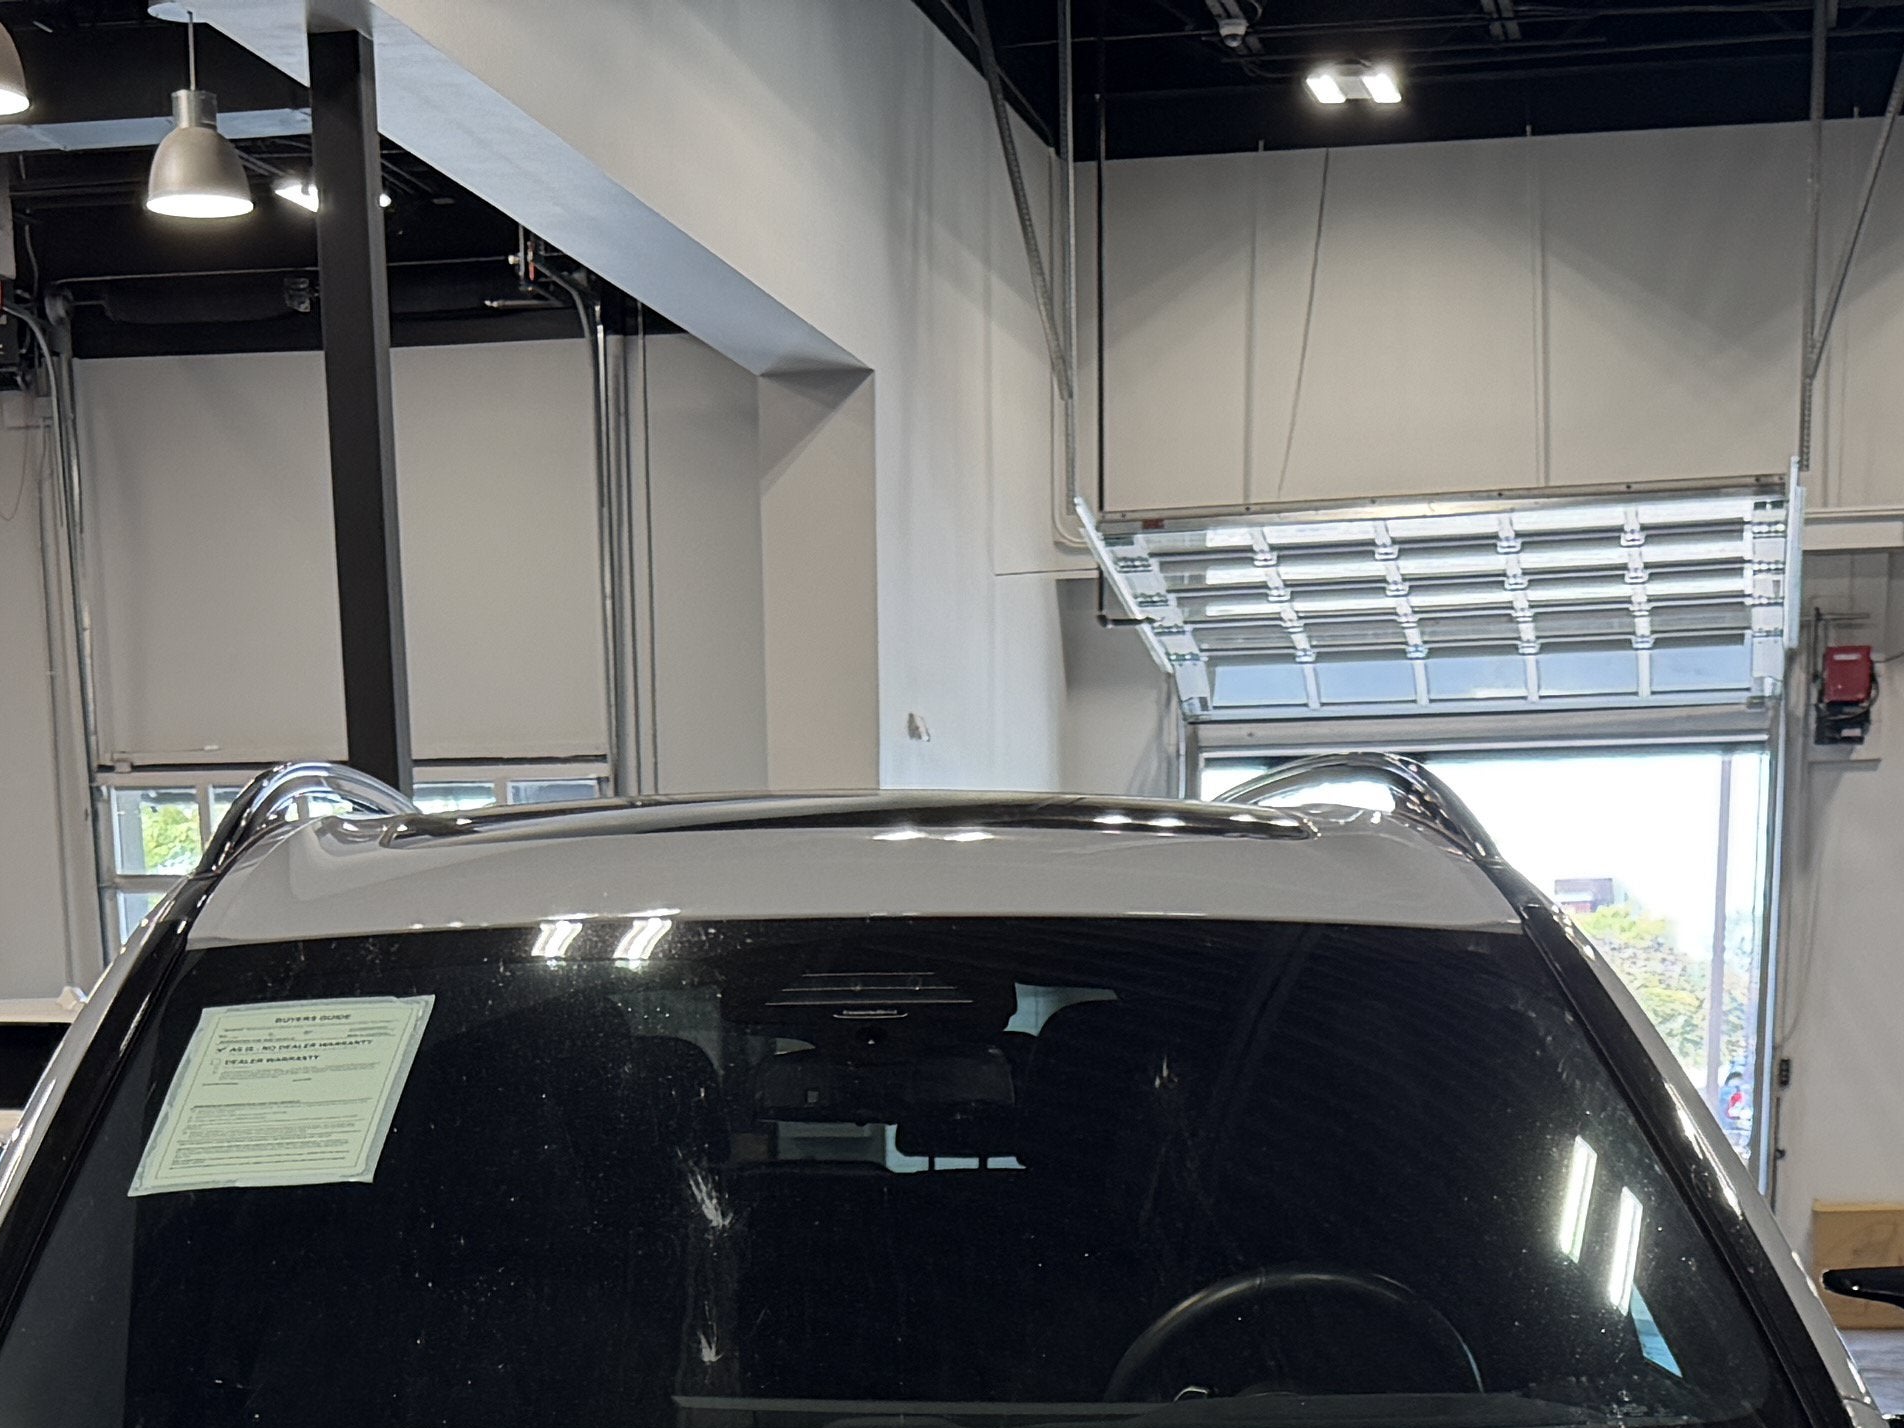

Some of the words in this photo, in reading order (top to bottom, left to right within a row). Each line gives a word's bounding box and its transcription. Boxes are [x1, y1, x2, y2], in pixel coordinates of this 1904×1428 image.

[274, 1015, 317, 1023] BUYERS
[319, 1013, 351, 1021] GUIDE
[278, 1042, 316, 1050] DEALER
[319, 1039, 372, 1048] WARRANTY
[266, 1055, 319, 1063] WARRANTY
